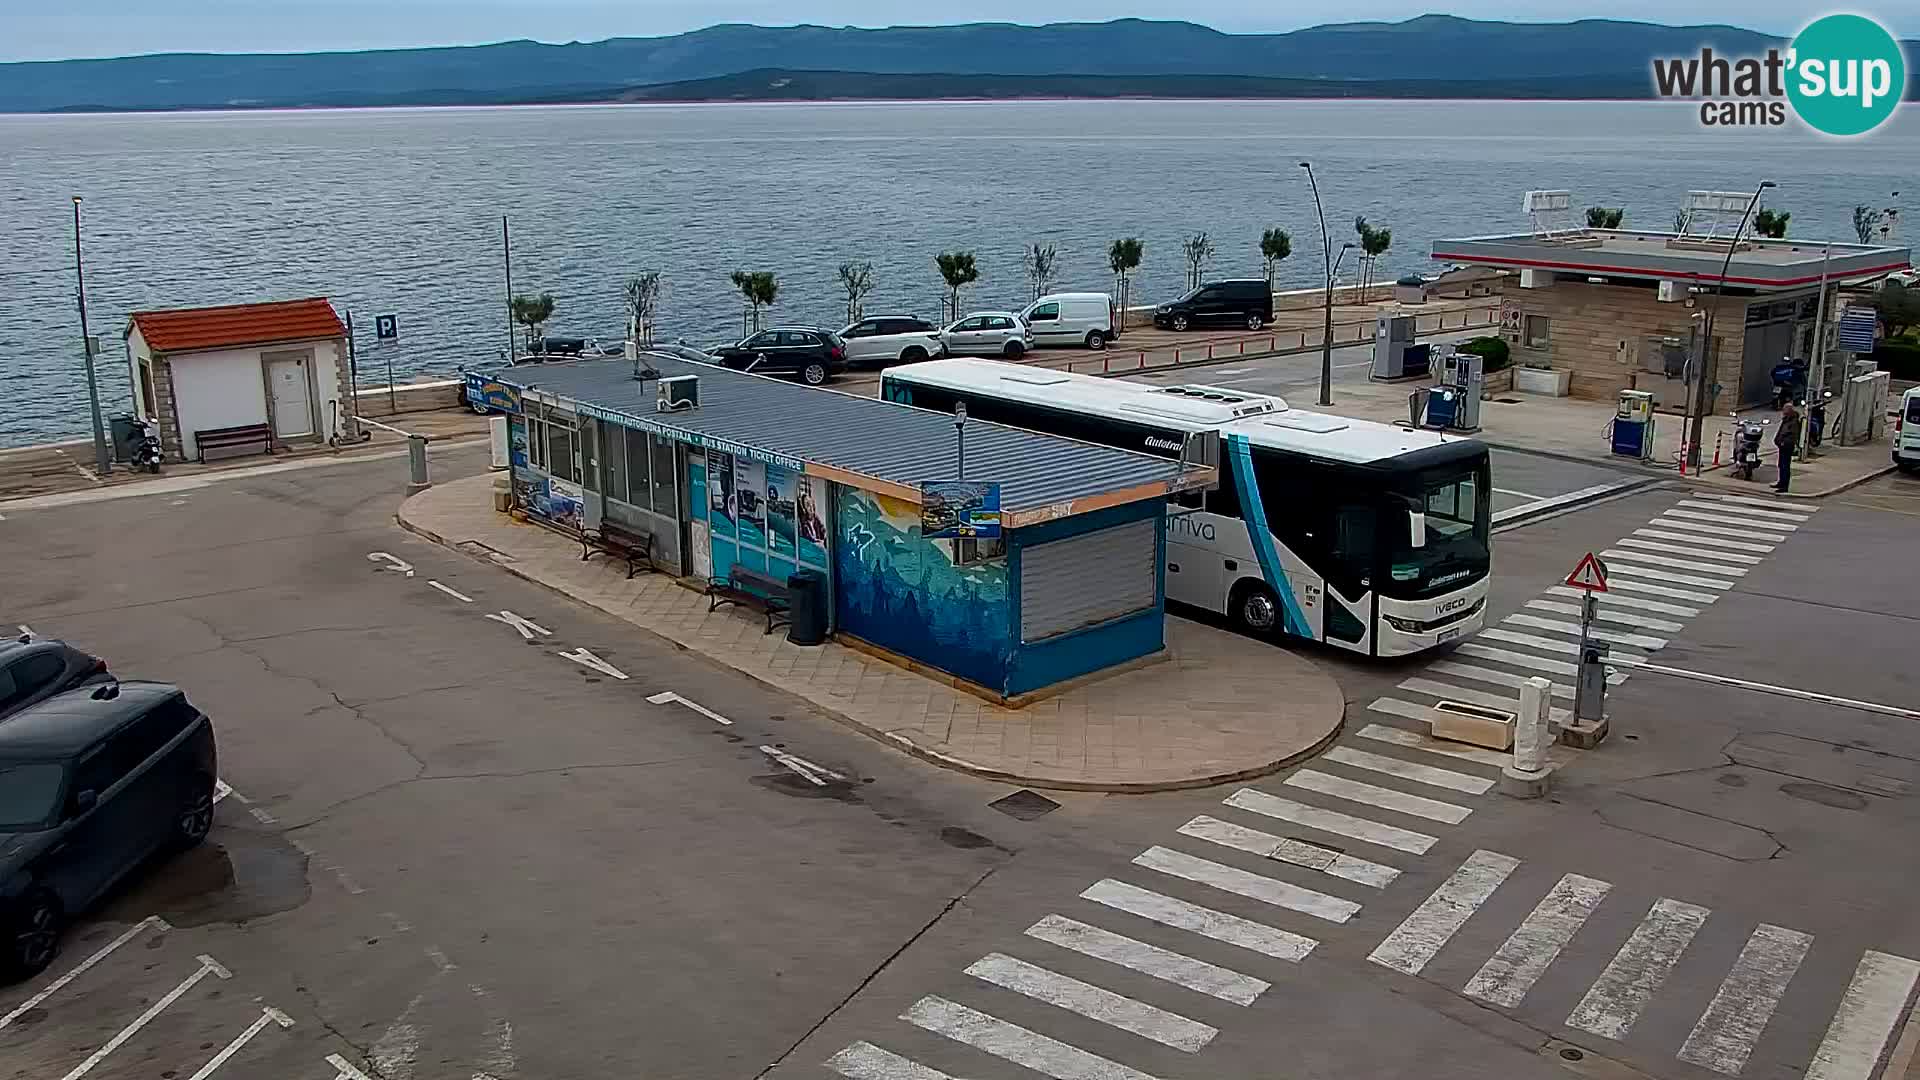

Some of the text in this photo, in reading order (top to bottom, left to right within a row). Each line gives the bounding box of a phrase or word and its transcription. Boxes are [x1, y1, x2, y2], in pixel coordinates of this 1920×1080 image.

[380, 318, 392, 336] P
[662, 426, 692, 442] POSTAJA
[702, 437, 717, 448] BUS
[717, 440, 747, 457] STATION
[750, 448, 774, 463] TICKET
[775, 455, 801, 470] OFFICE
[1435, 598, 1466, 615] IVECO
